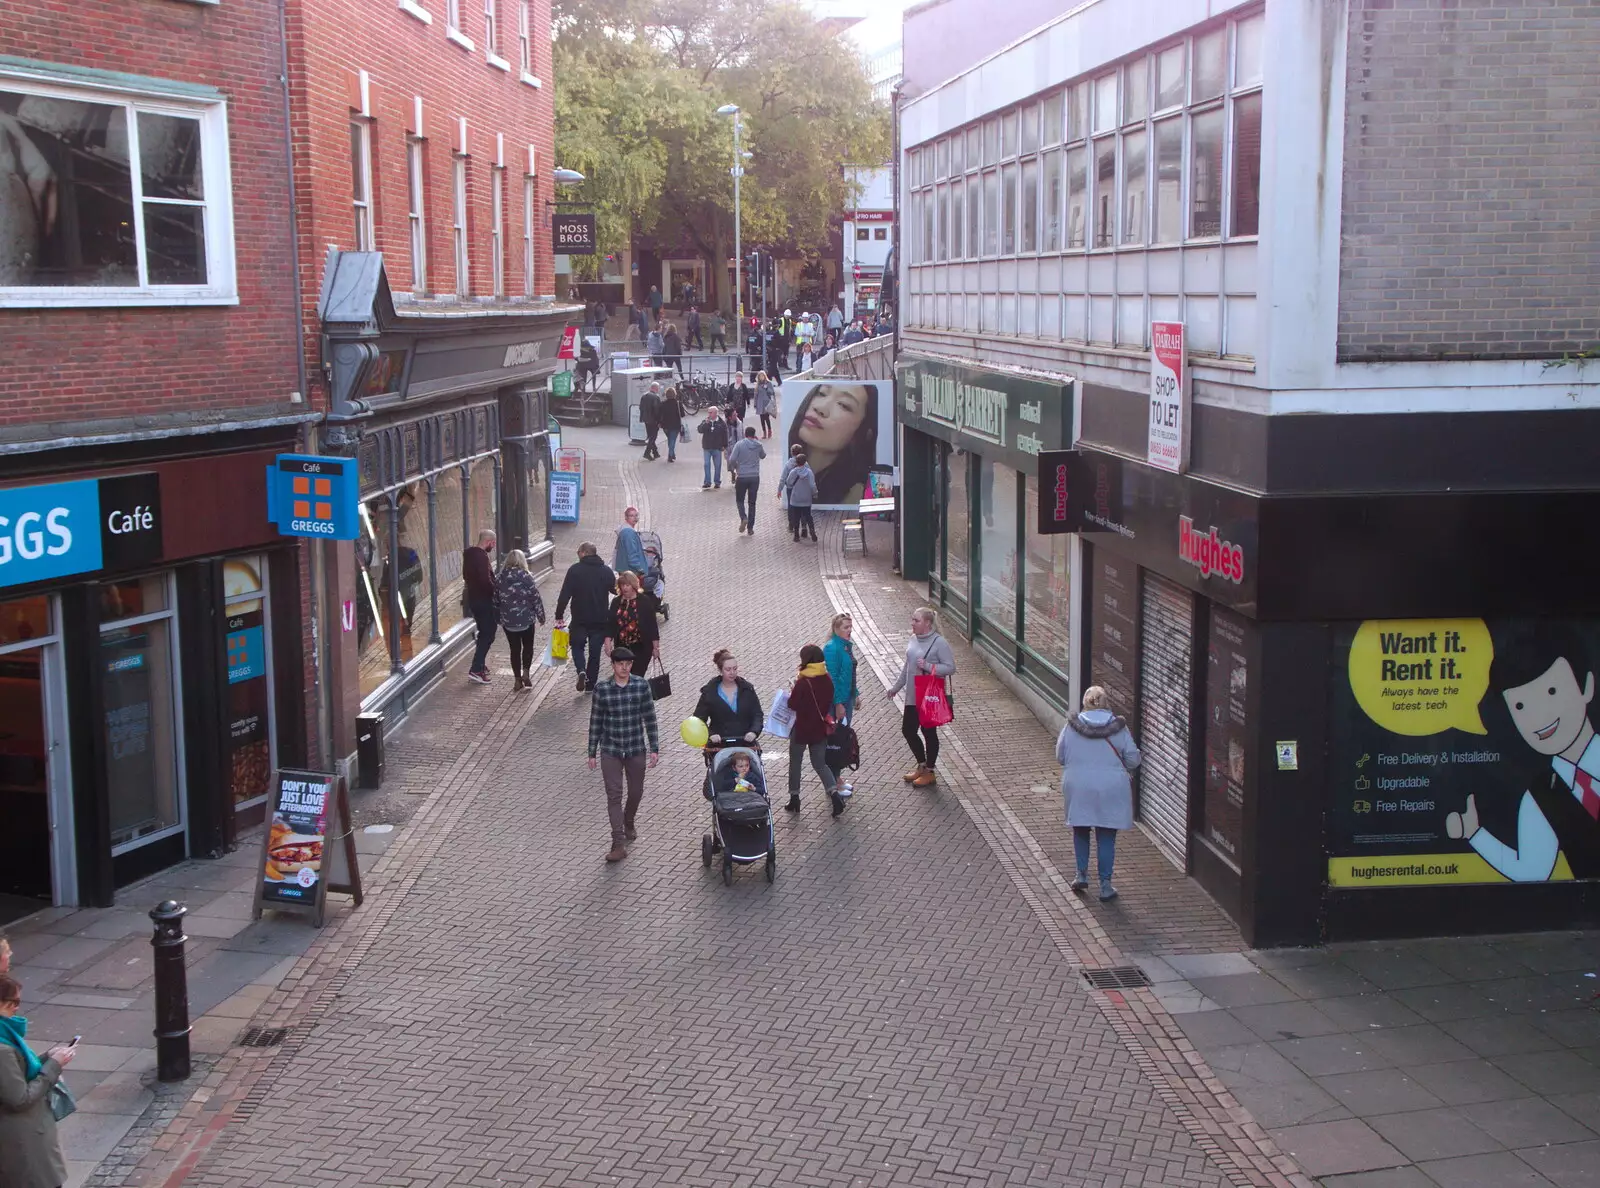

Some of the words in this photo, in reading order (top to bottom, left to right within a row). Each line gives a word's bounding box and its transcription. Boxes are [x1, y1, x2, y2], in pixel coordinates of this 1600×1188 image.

[559, 224, 588, 233] MOSS
[559, 233, 591, 243] BROS.
[1155, 375, 1175, 397] SHOP
[921, 373, 955, 420] HOLLAND
[964, 384, 1008, 447] BARRETT
[1152, 400, 1162, 425] TO
[1164, 403, 1180, 429] LET
[302, 462, 321, 473] Café
[1054, 464, 1068, 521] Hughes
[108, 506, 153, 535] Café
[291, 520, 335, 534] GREGGS
[1179, 514, 1244, 584] Hughes
[229, 618, 243, 628] Café
[1380, 633, 1437, 654] Want
[1444, 631, 1467, 653] it.
[114, 656, 141, 669] GREGGS
[1381, 659, 1432, 681] Rent
[1440, 658, 1463, 680] it.
[1381, 686, 1414, 698] Always
[1417, 687, 1439, 696] have
[1443, 686, 1459, 695] the
[1392, 700, 1423, 711] latest
[1426, 700, 1448, 710] tech
[1377, 753, 1398, 765] Free
[1401, 752, 1438, 767] Delivery
[1440, 752, 1449, 764] &
[1451, 751, 1500, 763] Installation
[282, 780, 307, 792] DON'T
[308, 783, 326, 794] YOU
[1377, 777, 1430, 790] Upgradable
[280, 791, 300, 803] JUST
[302, 793, 325, 806] LOVE
[1376, 801, 1397, 812] Free
[1400, 800, 1435, 812] Repairs
[1351, 864, 1459, 879] hughesrental.co.uk
